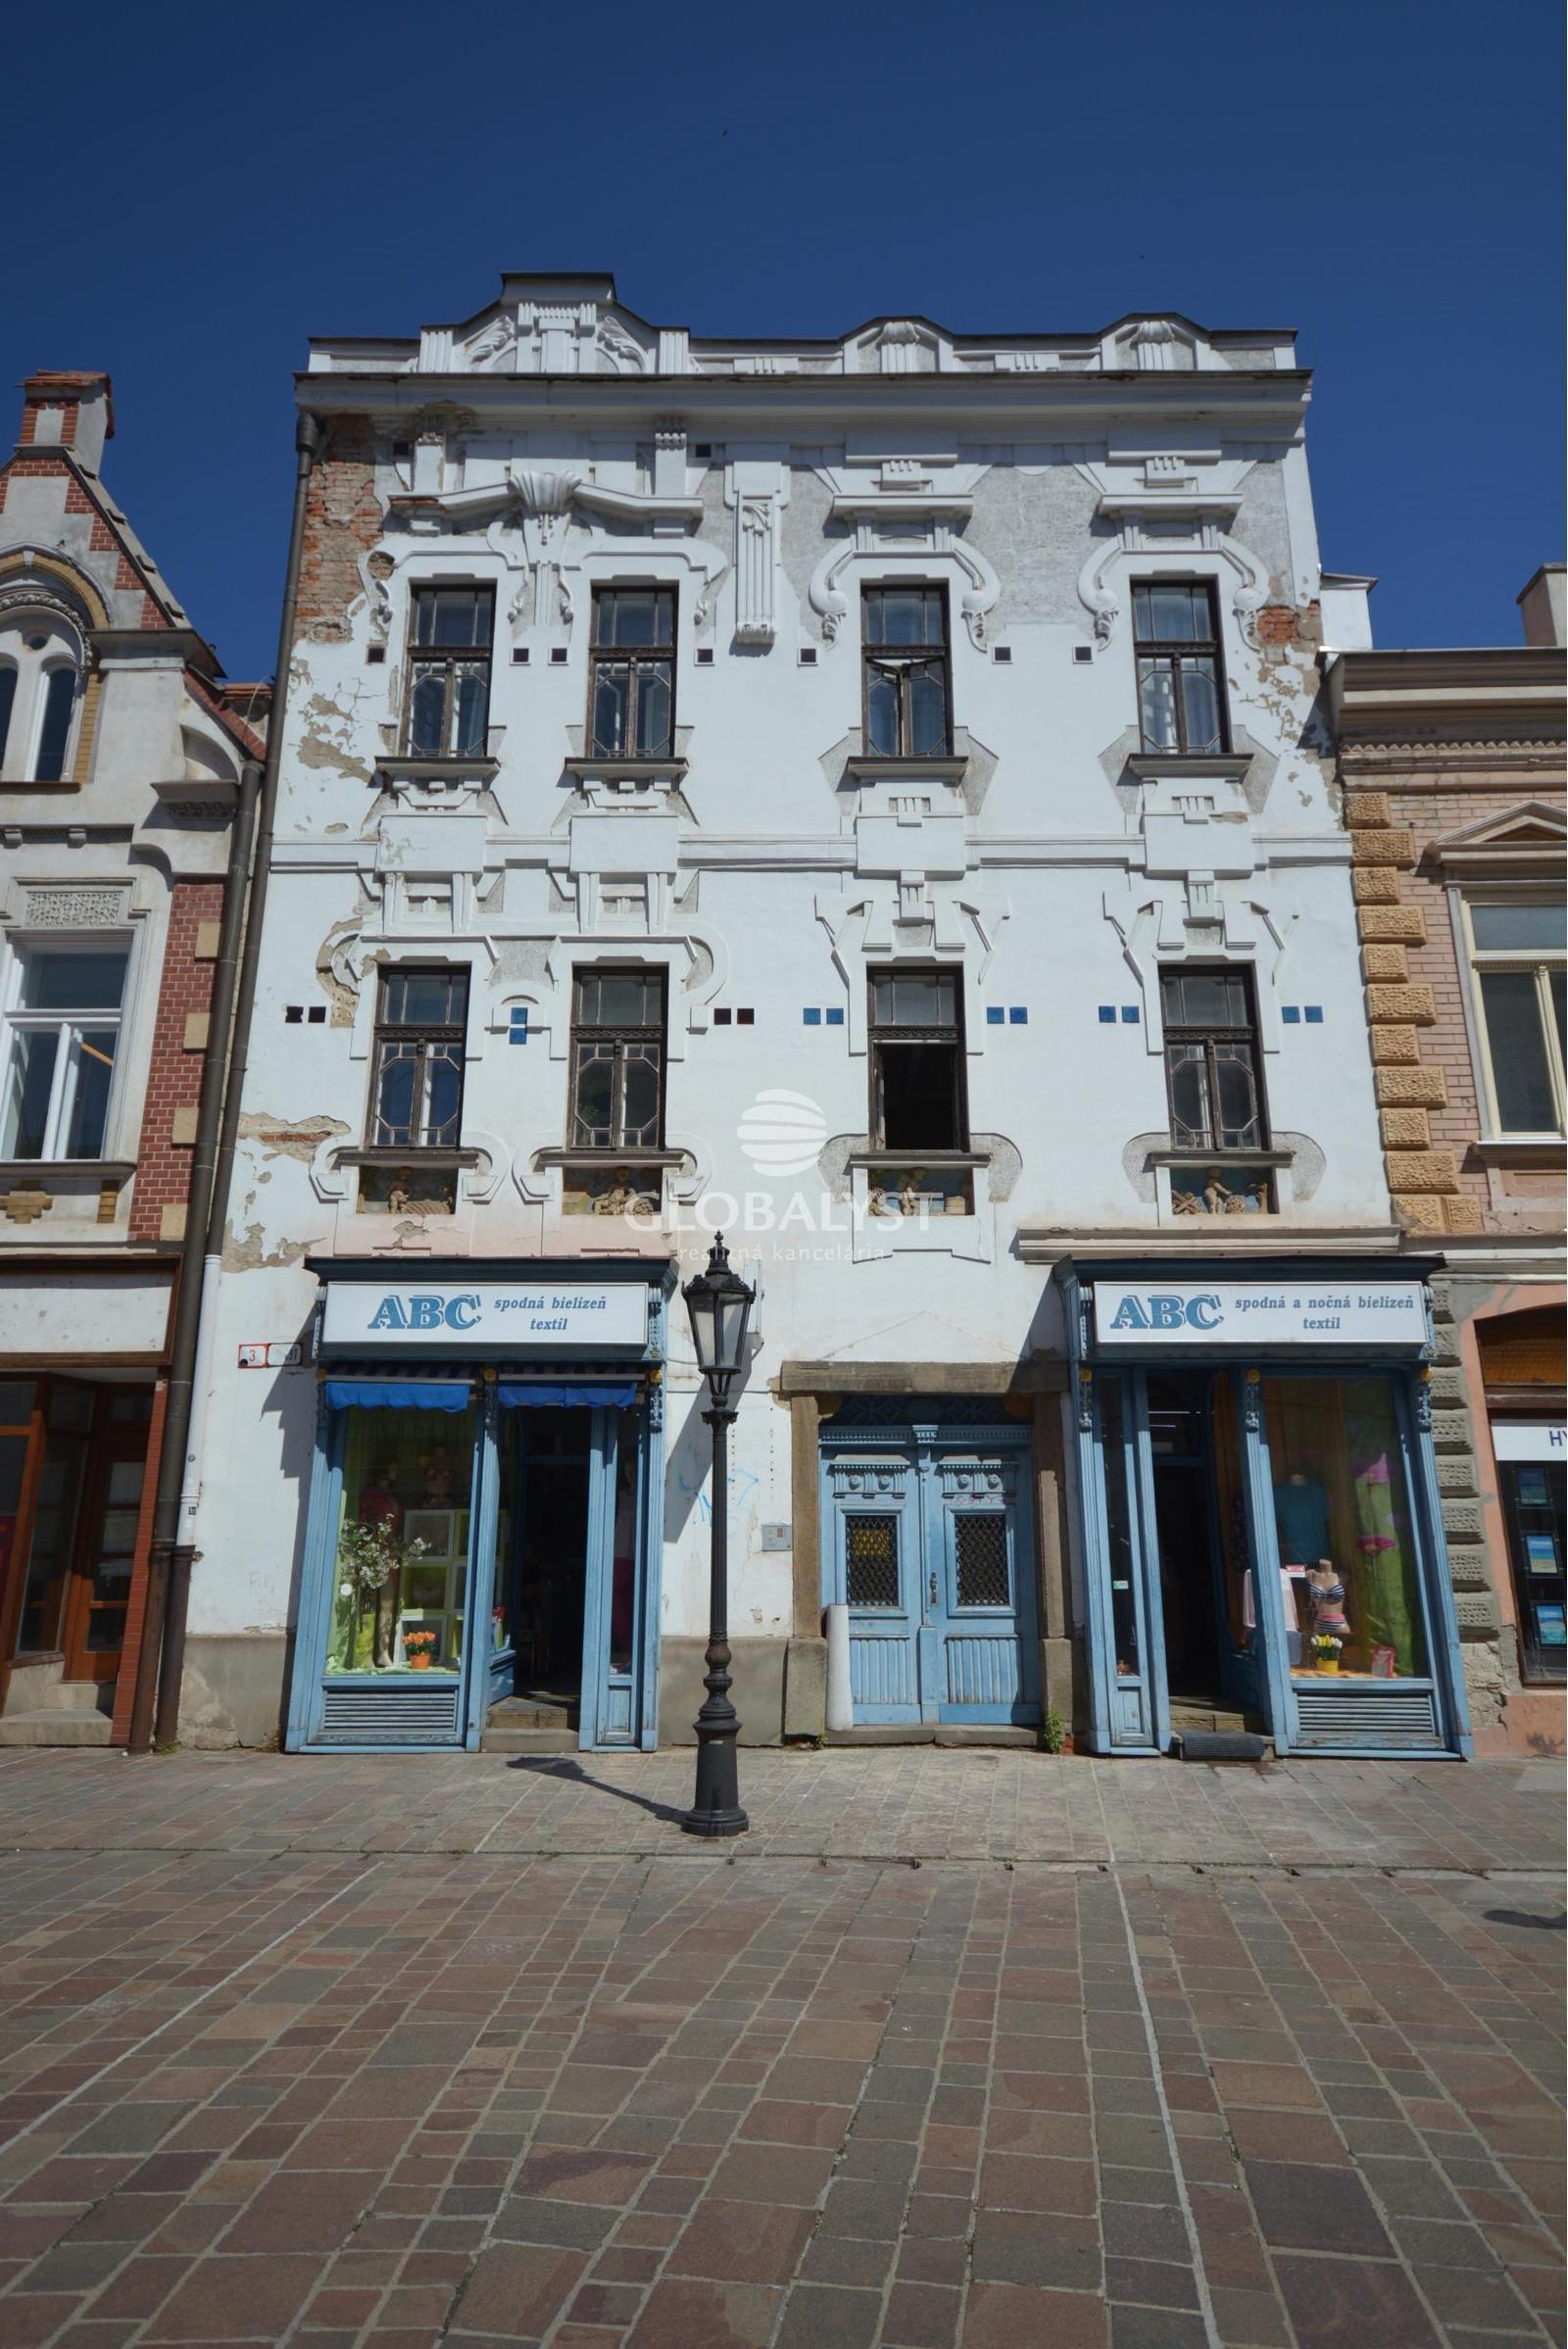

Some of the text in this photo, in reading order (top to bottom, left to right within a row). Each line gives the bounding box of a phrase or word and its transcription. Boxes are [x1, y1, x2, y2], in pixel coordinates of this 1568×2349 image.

[494, 1296, 606, 1311] spodná bielizeň
[1235, 1296, 1414, 1312] spodná a nočná bielizeň
[368, 1295, 482, 1330] ABC
[1109, 1295, 1224, 1330] ABC
[530, 1317, 567, 1330] textil
[1303, 1317, 1341, 1330] textil
[249, 1348, 256, 1361] 3
